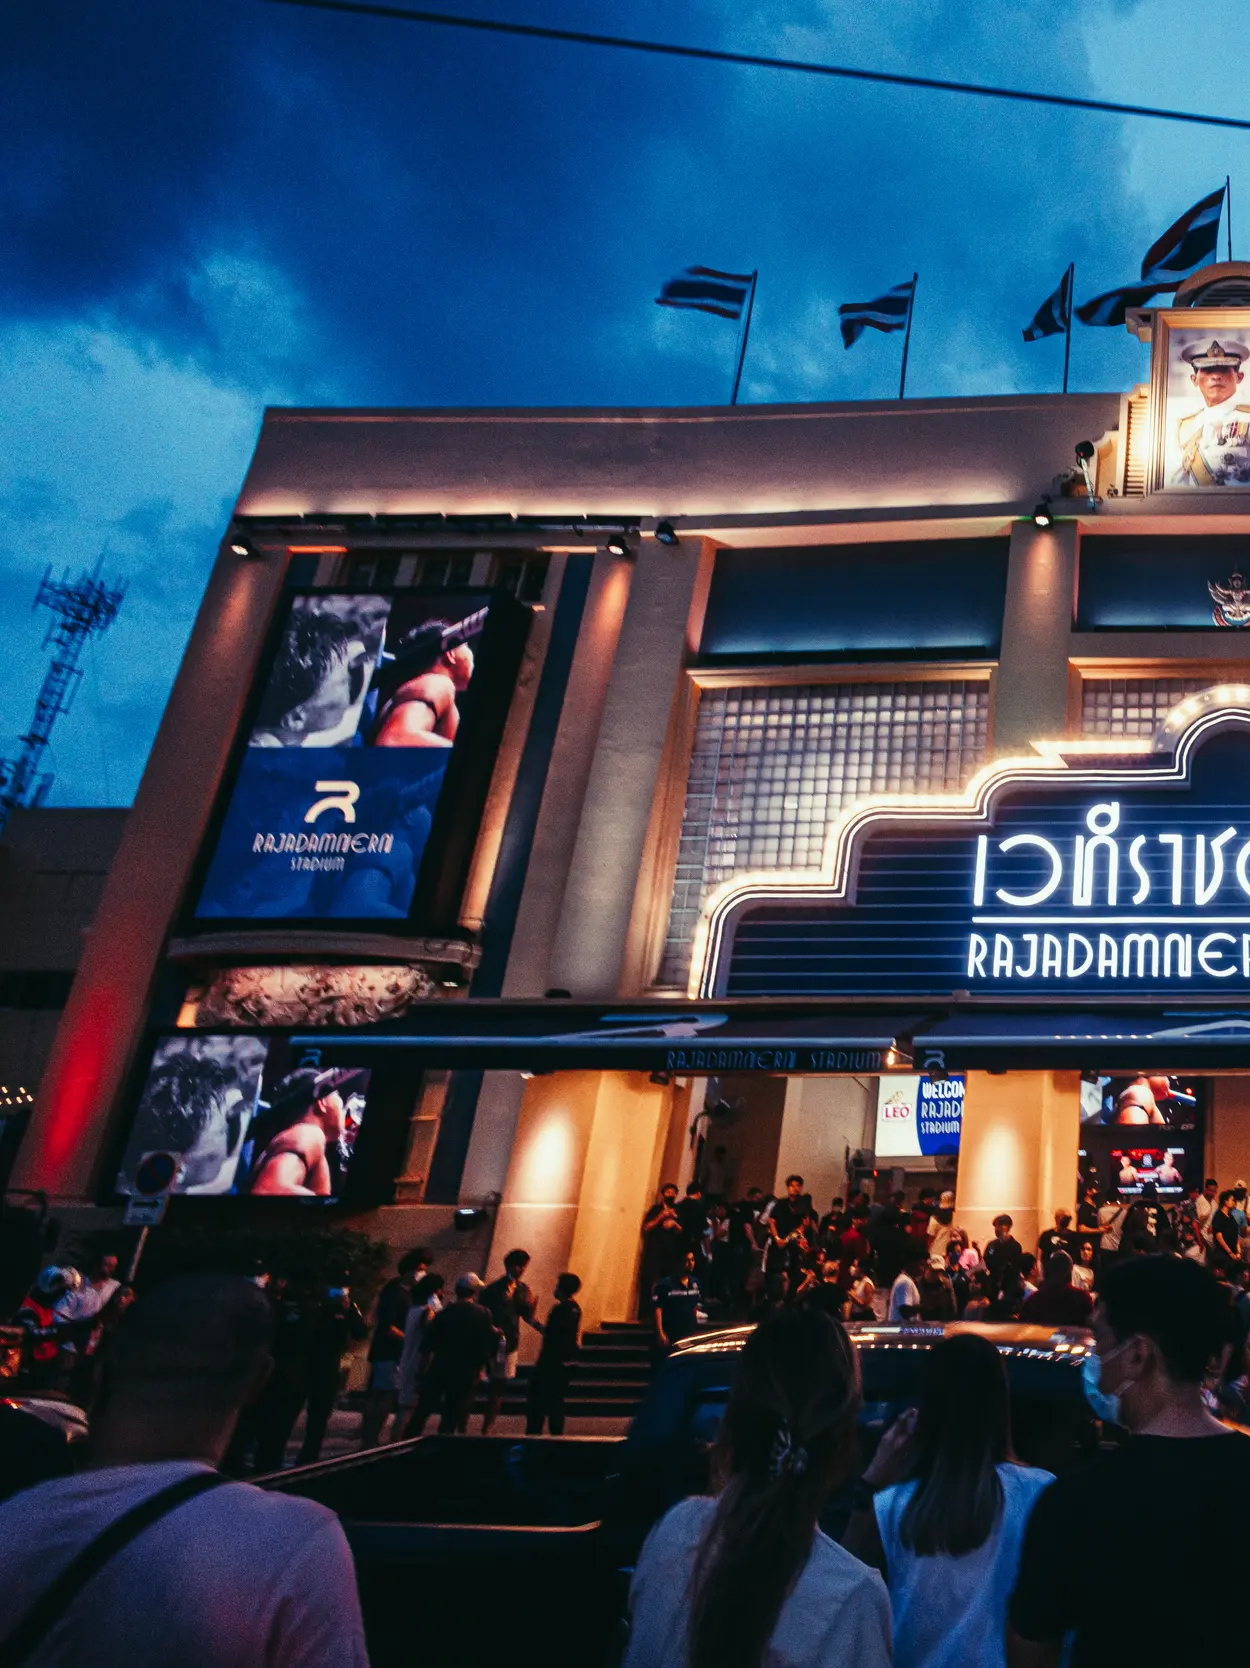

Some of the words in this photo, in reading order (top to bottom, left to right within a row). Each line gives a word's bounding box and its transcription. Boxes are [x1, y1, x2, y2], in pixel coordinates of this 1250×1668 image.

[253, 832, 394, 853] RAJADAMNERN
[290, 856, 346, 872] STADIUM
[666, 1049, 796, 1070] RAJADAMNERN
[811, 1050, 882, 1070] STADIUM
[885, 1106, 910, 1118] LEO
[920, 1120, 960, 1134] STADIUM
